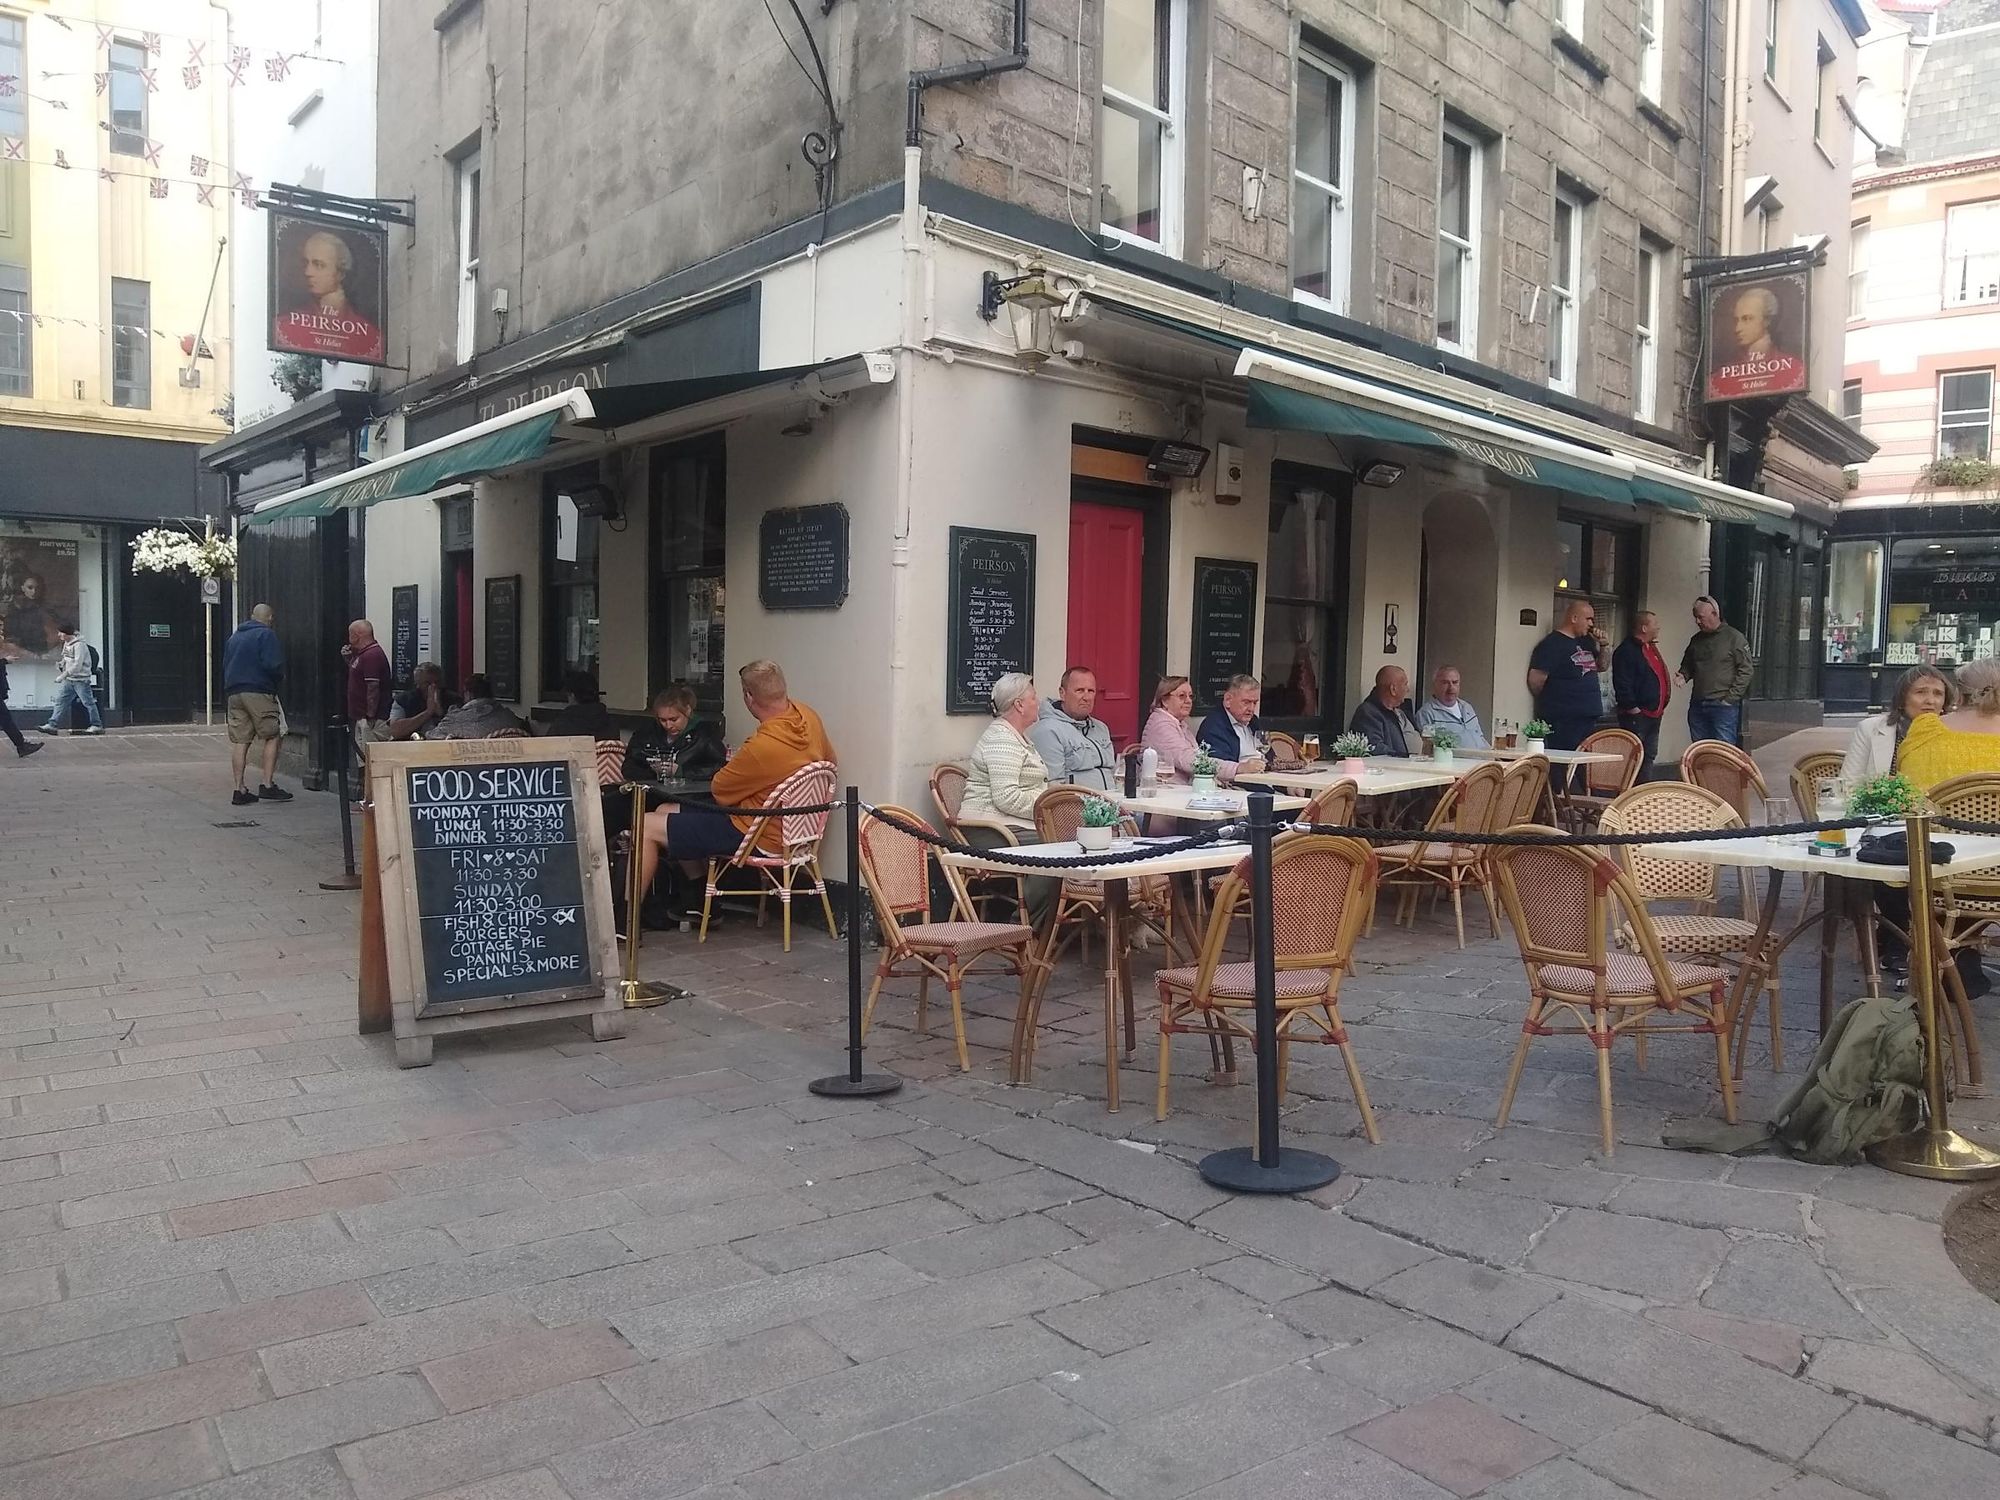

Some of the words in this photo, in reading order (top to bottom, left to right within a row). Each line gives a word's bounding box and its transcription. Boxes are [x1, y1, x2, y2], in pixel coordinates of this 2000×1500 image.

[321, 304, 339, 317] The
[289, 311, 369, 336] PEIRSON
[1750, 352, 1766, 361] The
[1720, 357, 1793, 379] PEIRSON
[1453, 437, 1540, 479] PEIRSON
[341, 468, 405, 504] PEIRSON
[972, 558, 1016, 572] PEIRSON
[970, 586, 985, 596] Food
[1210, 584, 1242, 595] PEIRSON
[411, 769, 474, 802] FOOD
[479, 767, 565, 799] SERVICE
[491, 803, 566, 819] THURSDAY
[434, 819, 482, 832] LUNCH
[490, 818, 564, 831] 11:30-3:30
[434, 831, 488, 845] DINNER
[495, 831, 565, 843] 5:30-8:30
[451, 849, 480, 868] FRI
[492, 848, 505, 866] &
[515, 847, 548, 866] SAT
[456, 867, 538, 881] 11:30-3:30
[453, 881, 527, 899] SUNDAY
[454, 893, 542, 915] 11:30-3:00
[444, 915, 479, 931] FISH
[482, 913, 494, 929] &
[497, 910, 547, 926] CHIPS
[454, 926, 531, 942] BURGERS
[450, 939, 515, 957] COTTAGE
[521, 935, 547, 949] PIE
[466, 949, 531, 967] PANINIS
